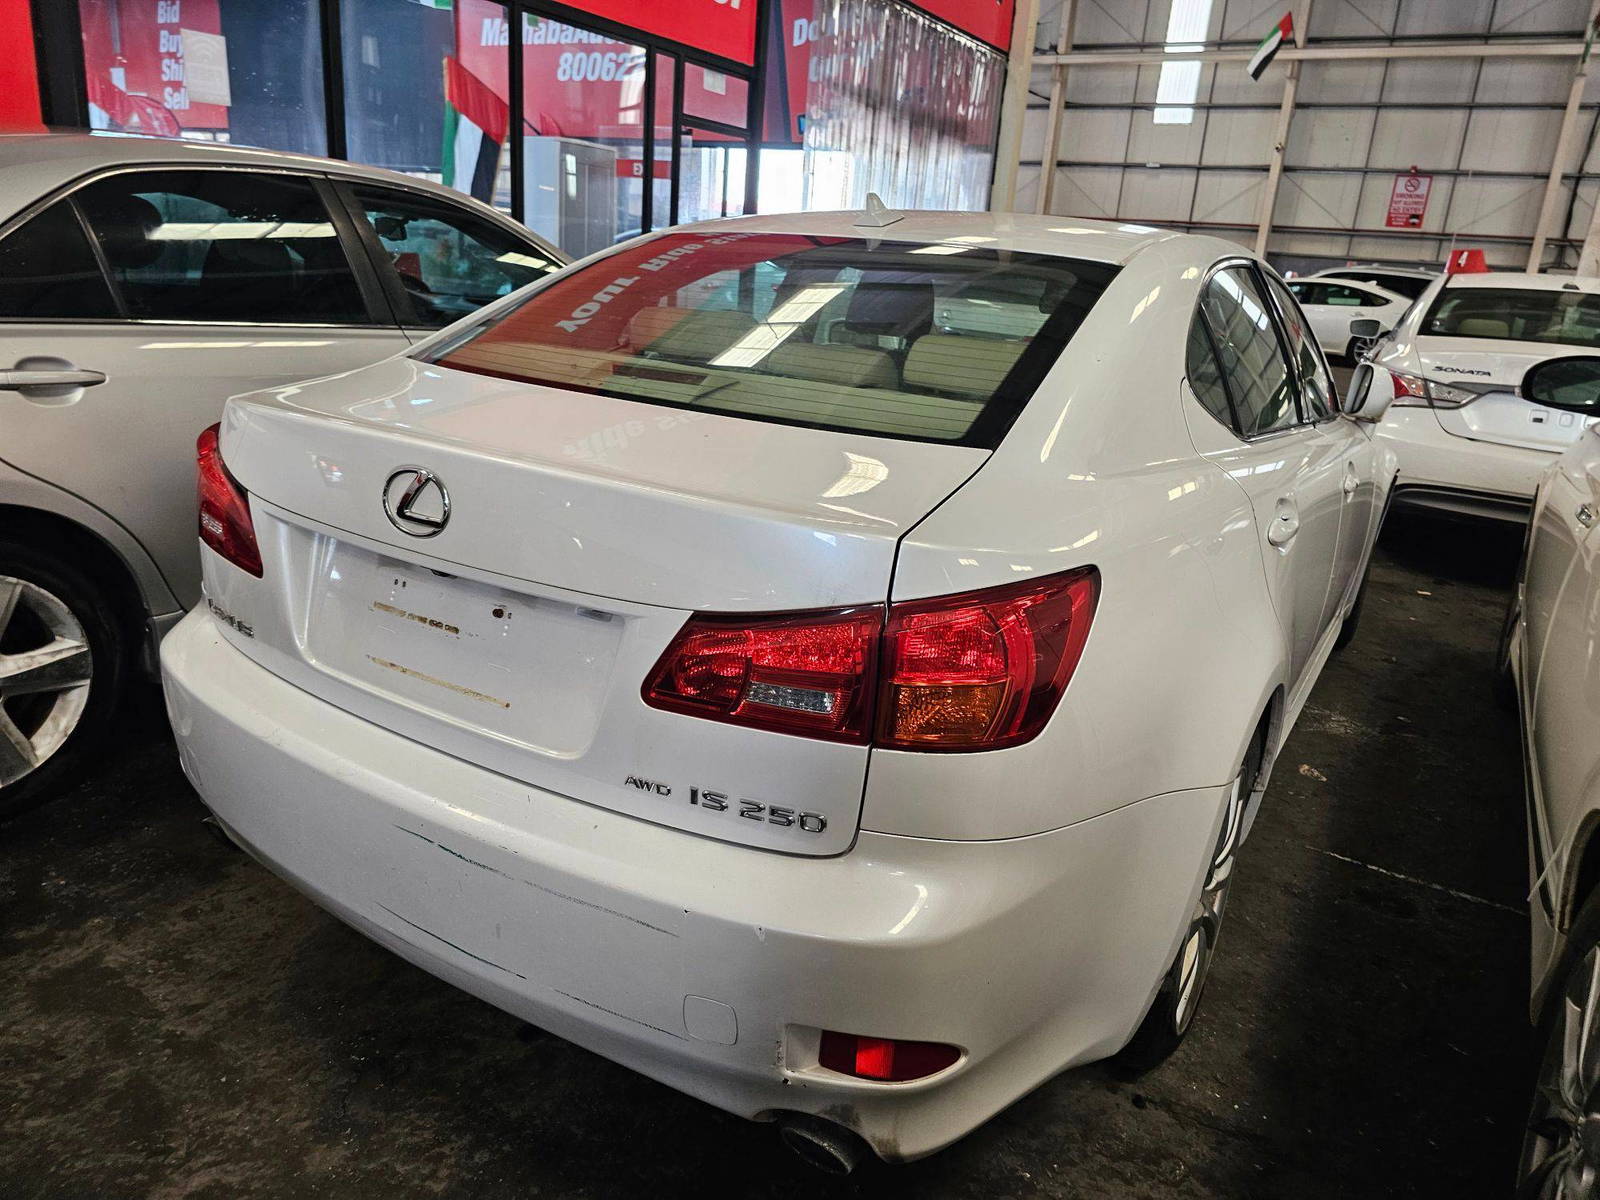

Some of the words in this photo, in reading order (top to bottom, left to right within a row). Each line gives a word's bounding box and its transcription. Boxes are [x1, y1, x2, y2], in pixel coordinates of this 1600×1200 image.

[157, 1, 181, 24] Bid
[159, 30, 184, 57] Buy
[161, 58, 186, 82] Shi
[1432, 366, 1492, 377] SONATA
[624, 775, 672, 796] AWD
[689, 786, 729, 812] IS
[739, 798, 827, 833] 250
